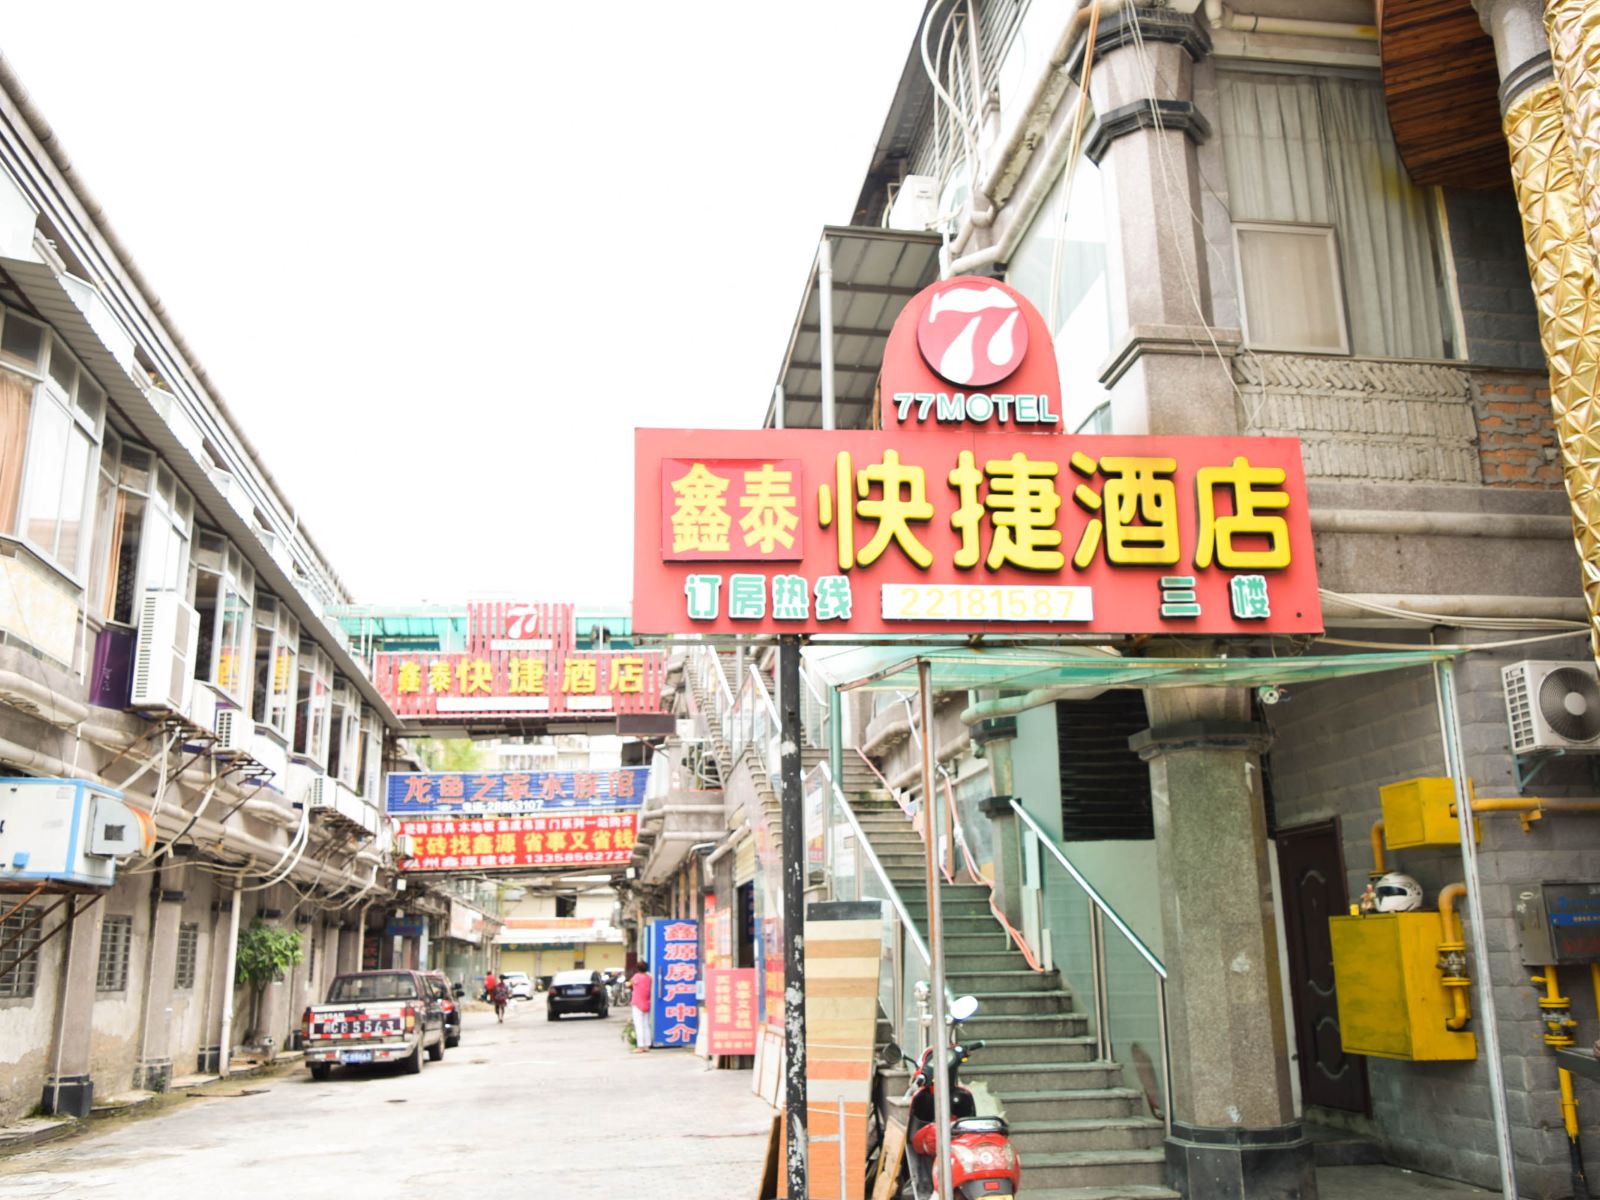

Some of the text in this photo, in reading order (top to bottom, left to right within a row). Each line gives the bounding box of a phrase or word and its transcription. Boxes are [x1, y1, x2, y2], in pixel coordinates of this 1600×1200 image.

[893, 392, 1059, 423] 77MOTEL
[684, 574, 1272, 620] 订房热线 22181587 三楼
[403, 770, 635, 804] 龙鱼之家水族馆
[524, 829, 634, 853] 省事又省钱
[664, 922, 699, 1043] 鑫源房产中介
